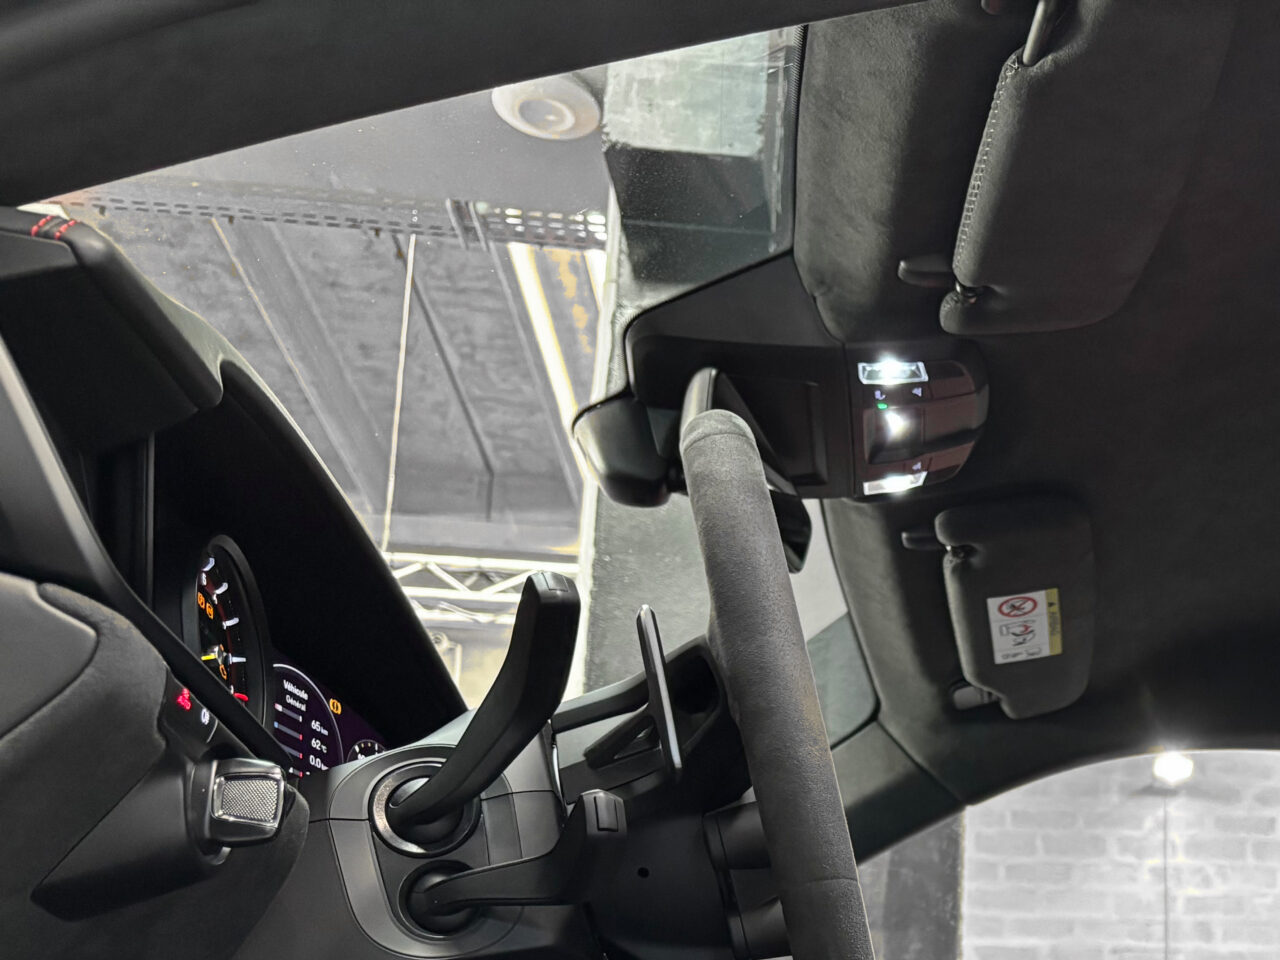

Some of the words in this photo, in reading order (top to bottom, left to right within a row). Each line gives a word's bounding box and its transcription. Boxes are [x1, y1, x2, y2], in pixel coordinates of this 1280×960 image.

[311, 719, 321, 732] 65
[311, 737, 321, 750] 62
[309, 754, 321, 768] 0.0
